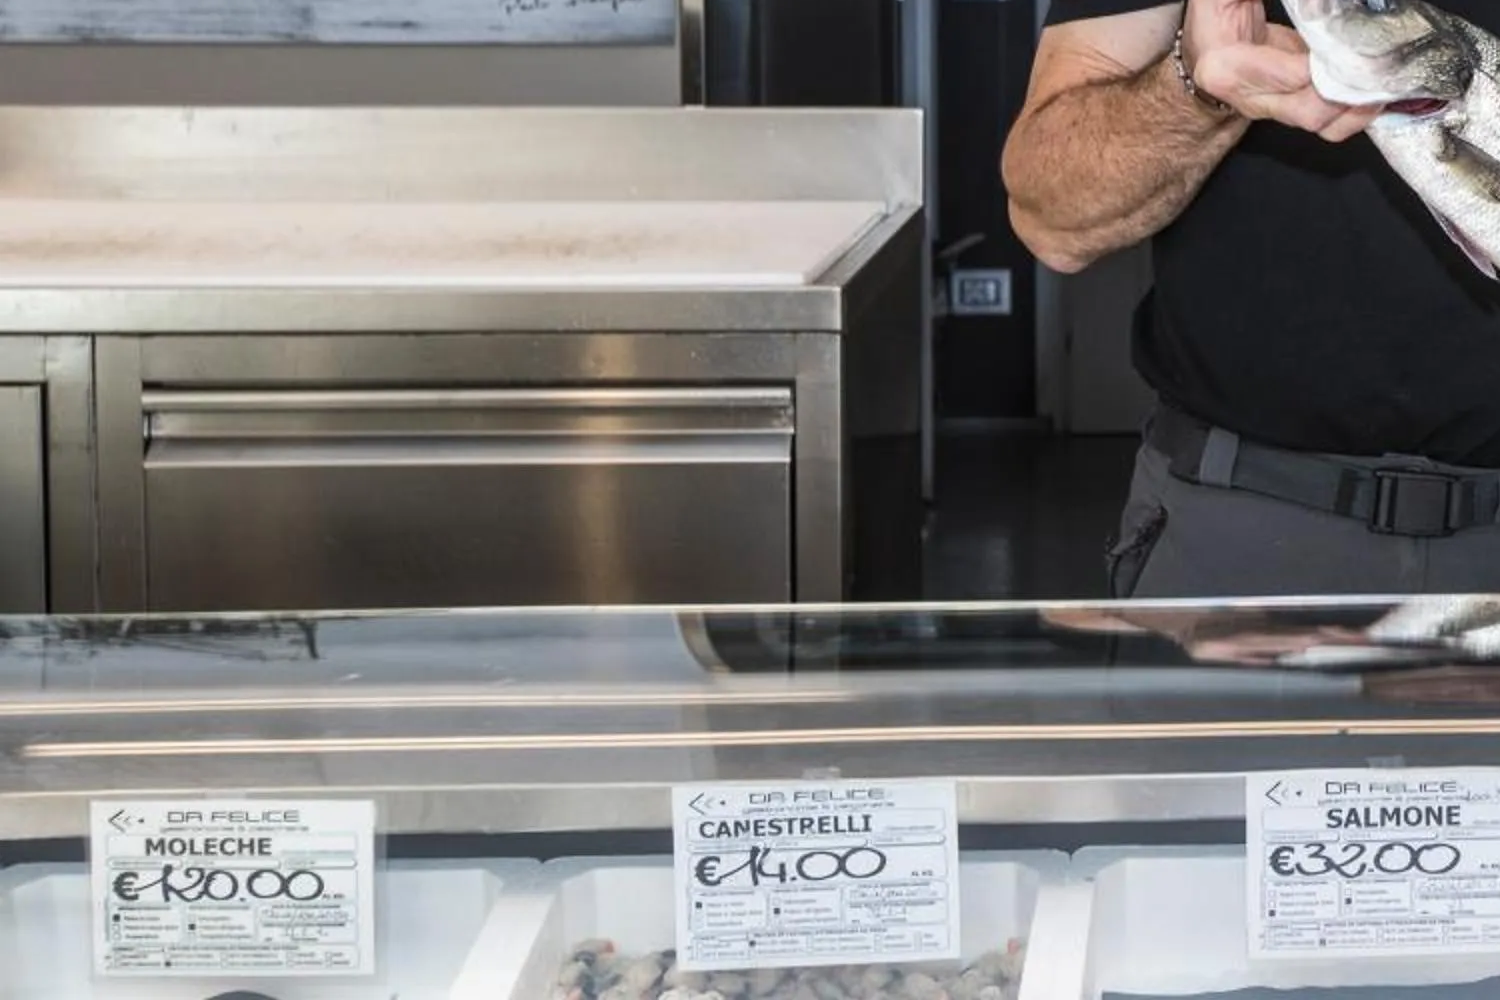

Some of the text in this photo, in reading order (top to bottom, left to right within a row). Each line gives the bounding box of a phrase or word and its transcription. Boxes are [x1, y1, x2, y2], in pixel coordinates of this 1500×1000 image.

[1368, 780, 1458, 793] FELICE
[167, 810, 300, 823] DA FELICE
[1326, 805, 1461, 829] SALMONE
[699, 814, 873, 839] CANESTRELLI
[145, 838, 273, 857] MOLECHE
